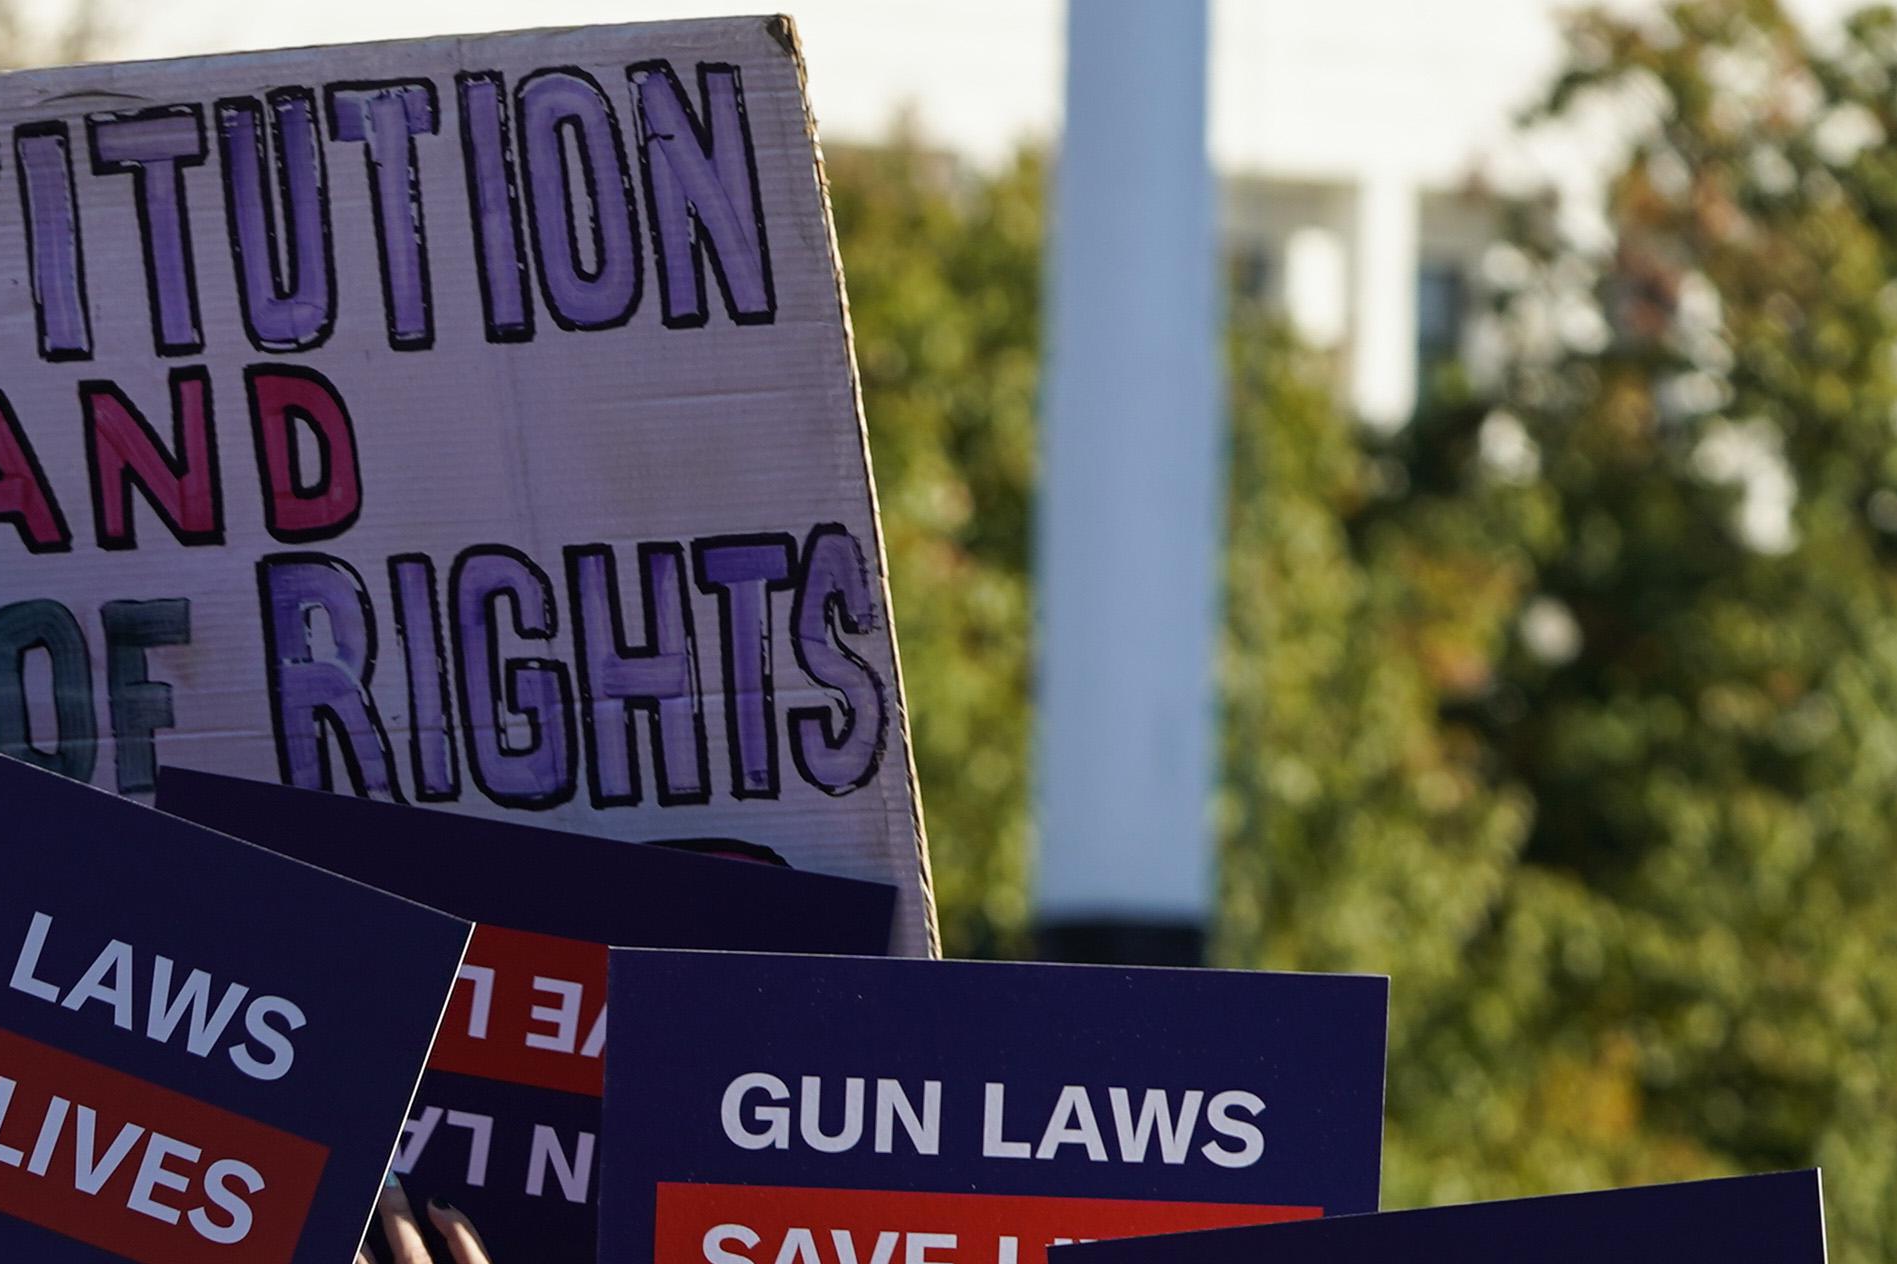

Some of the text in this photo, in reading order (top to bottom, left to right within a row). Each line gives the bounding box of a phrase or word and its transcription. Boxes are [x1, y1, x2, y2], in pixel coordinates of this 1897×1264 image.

[256, 522, 892, 811] RIGHTS
[9, 911, 307, 1081] LAWS
[720, 1072, 1267, 1169] GUN LAWS
